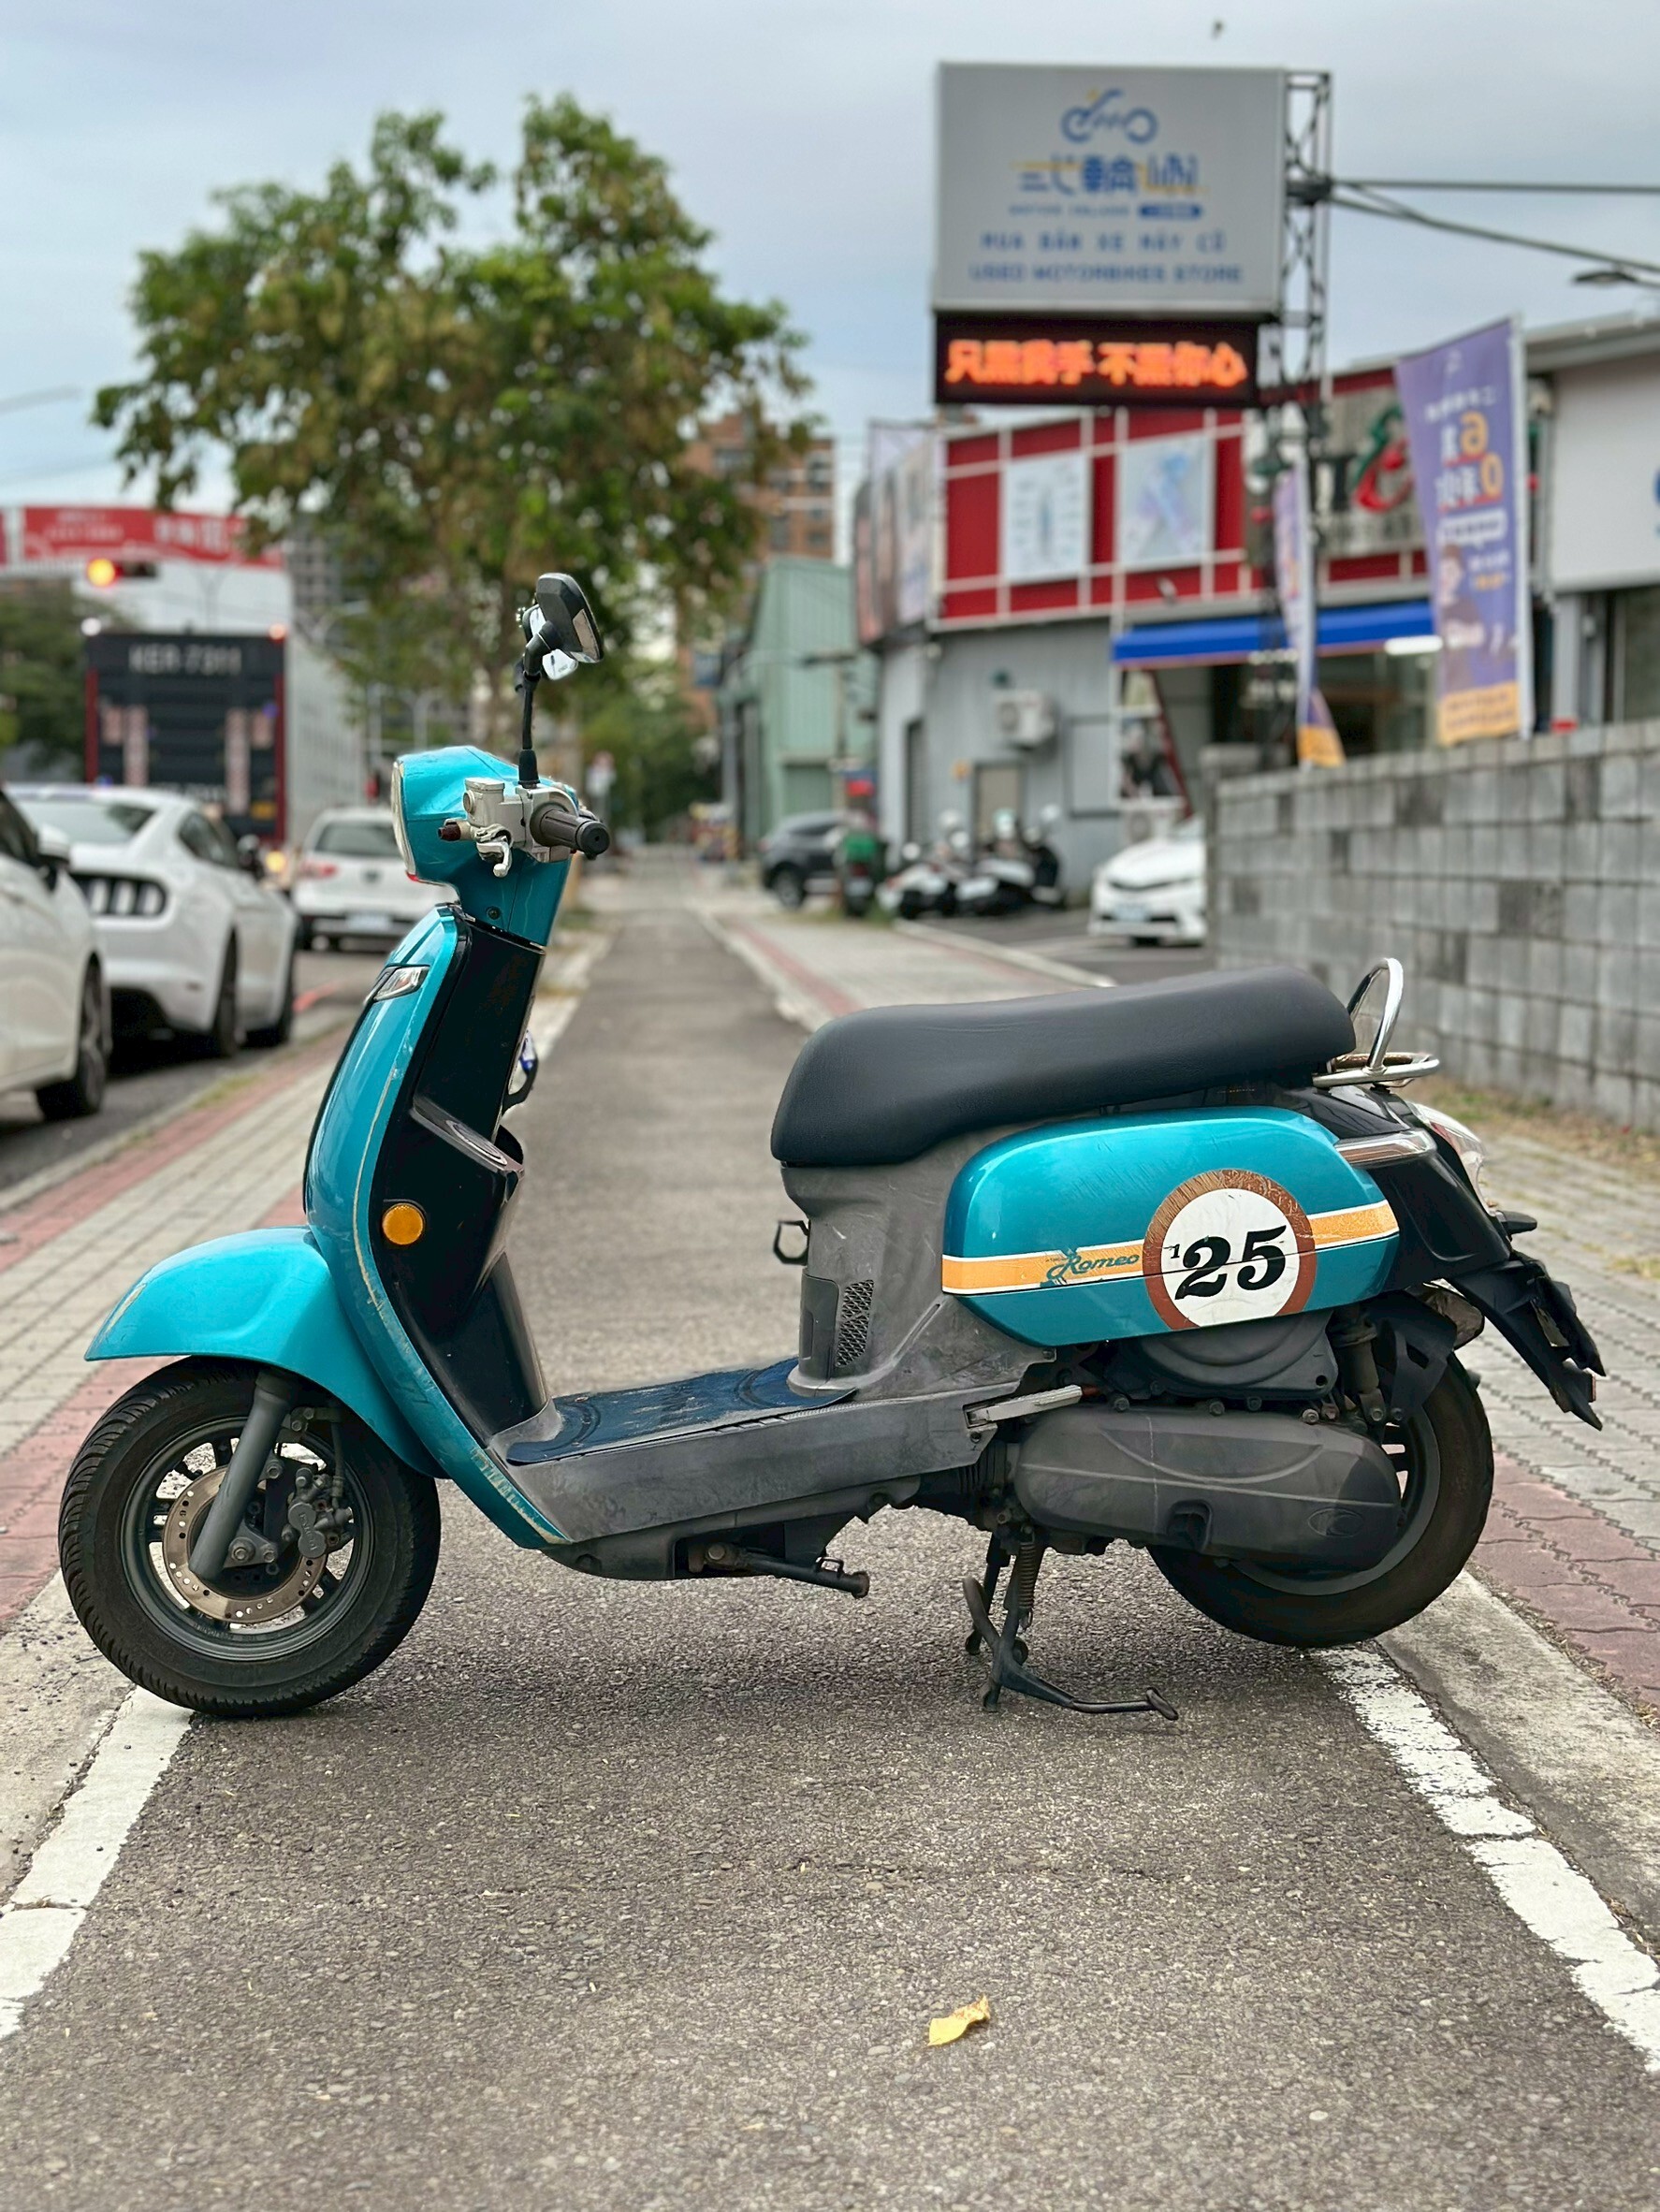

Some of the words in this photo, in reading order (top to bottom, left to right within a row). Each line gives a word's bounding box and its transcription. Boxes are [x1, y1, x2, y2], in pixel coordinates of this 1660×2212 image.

[968, 263, 1027, 283] USED
[1172, 263, 1244, 284] STORE
[1046, 1250, 1141, 1282] Romeo
[1170, 1225, 1287, 1301] 125
